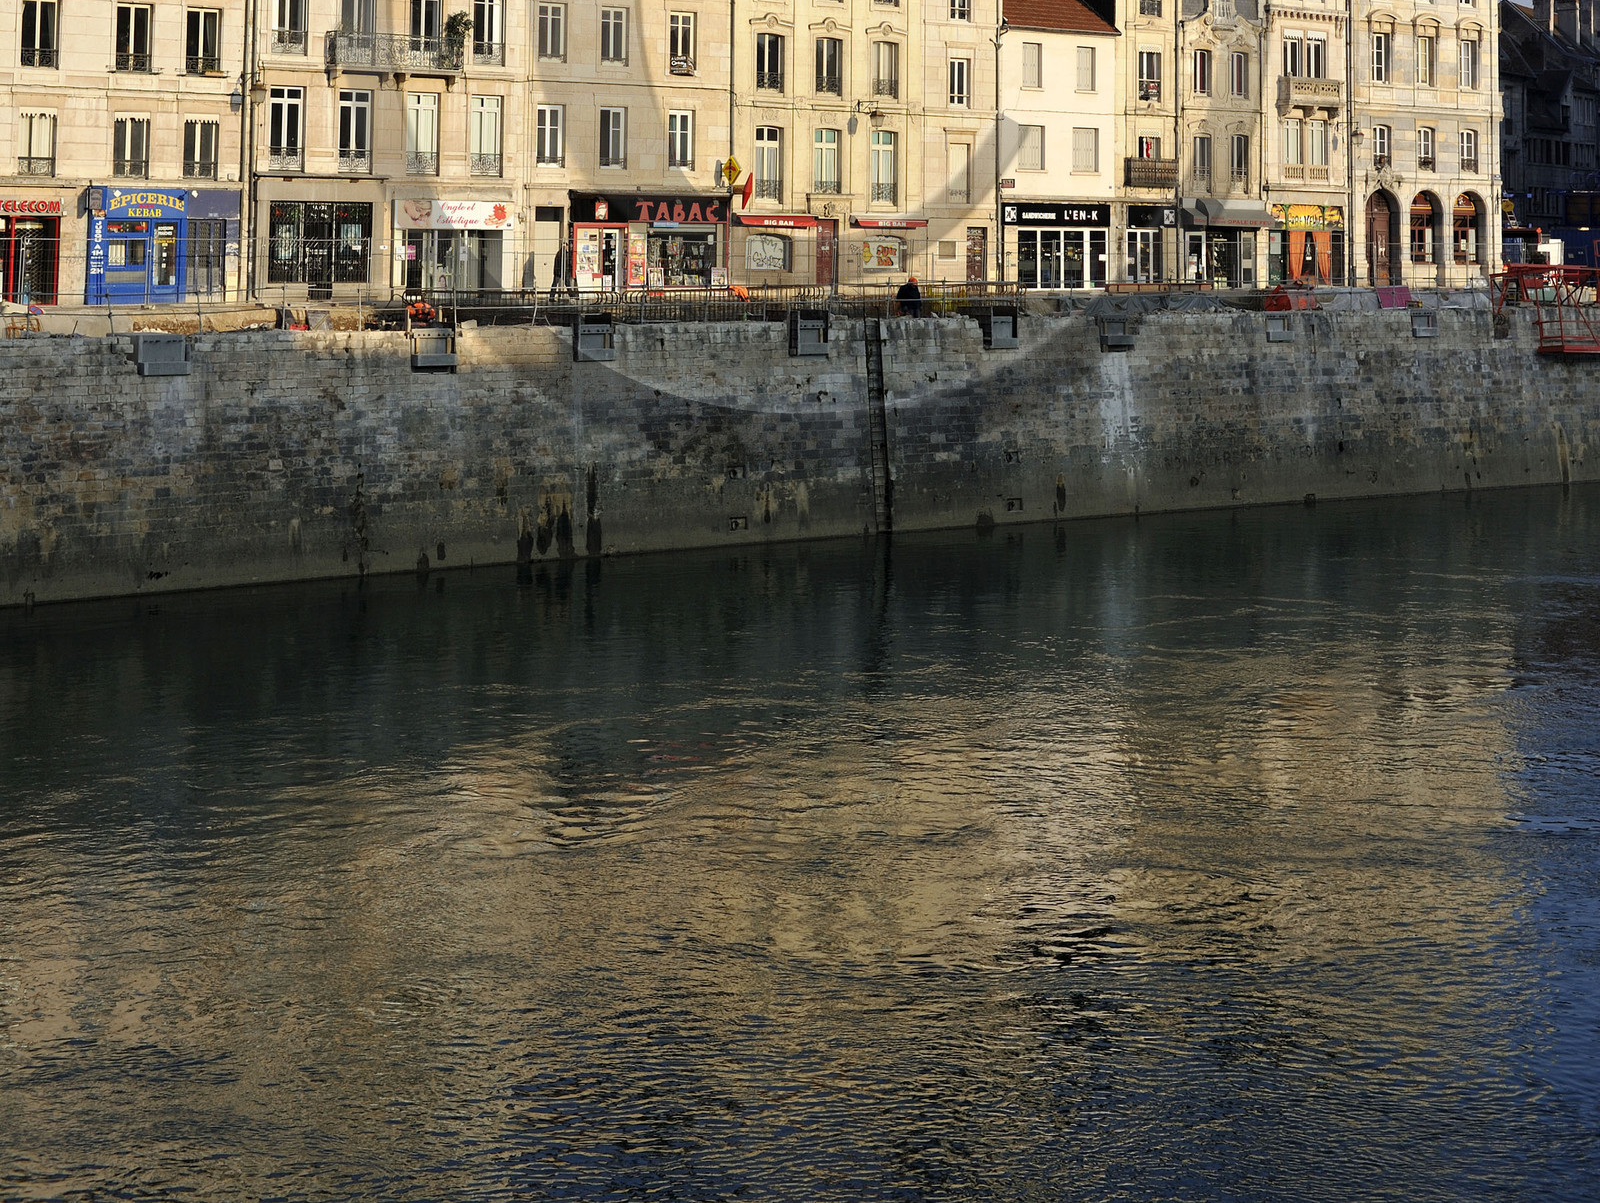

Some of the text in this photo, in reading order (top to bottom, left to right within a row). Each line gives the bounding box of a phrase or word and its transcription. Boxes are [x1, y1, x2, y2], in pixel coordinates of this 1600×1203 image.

[109, 193, 185, 211] EPICERIE
[441, 202, 465, 214] Ongle
[128, 208, 162, 217] KEBAB
[635, 201, 719, 222] TABAC
[1064, 210, 1098, 221] L'EN-K
[436, 215, 479, 228] Esthétique
[90, 267, 104, 275] 2H
